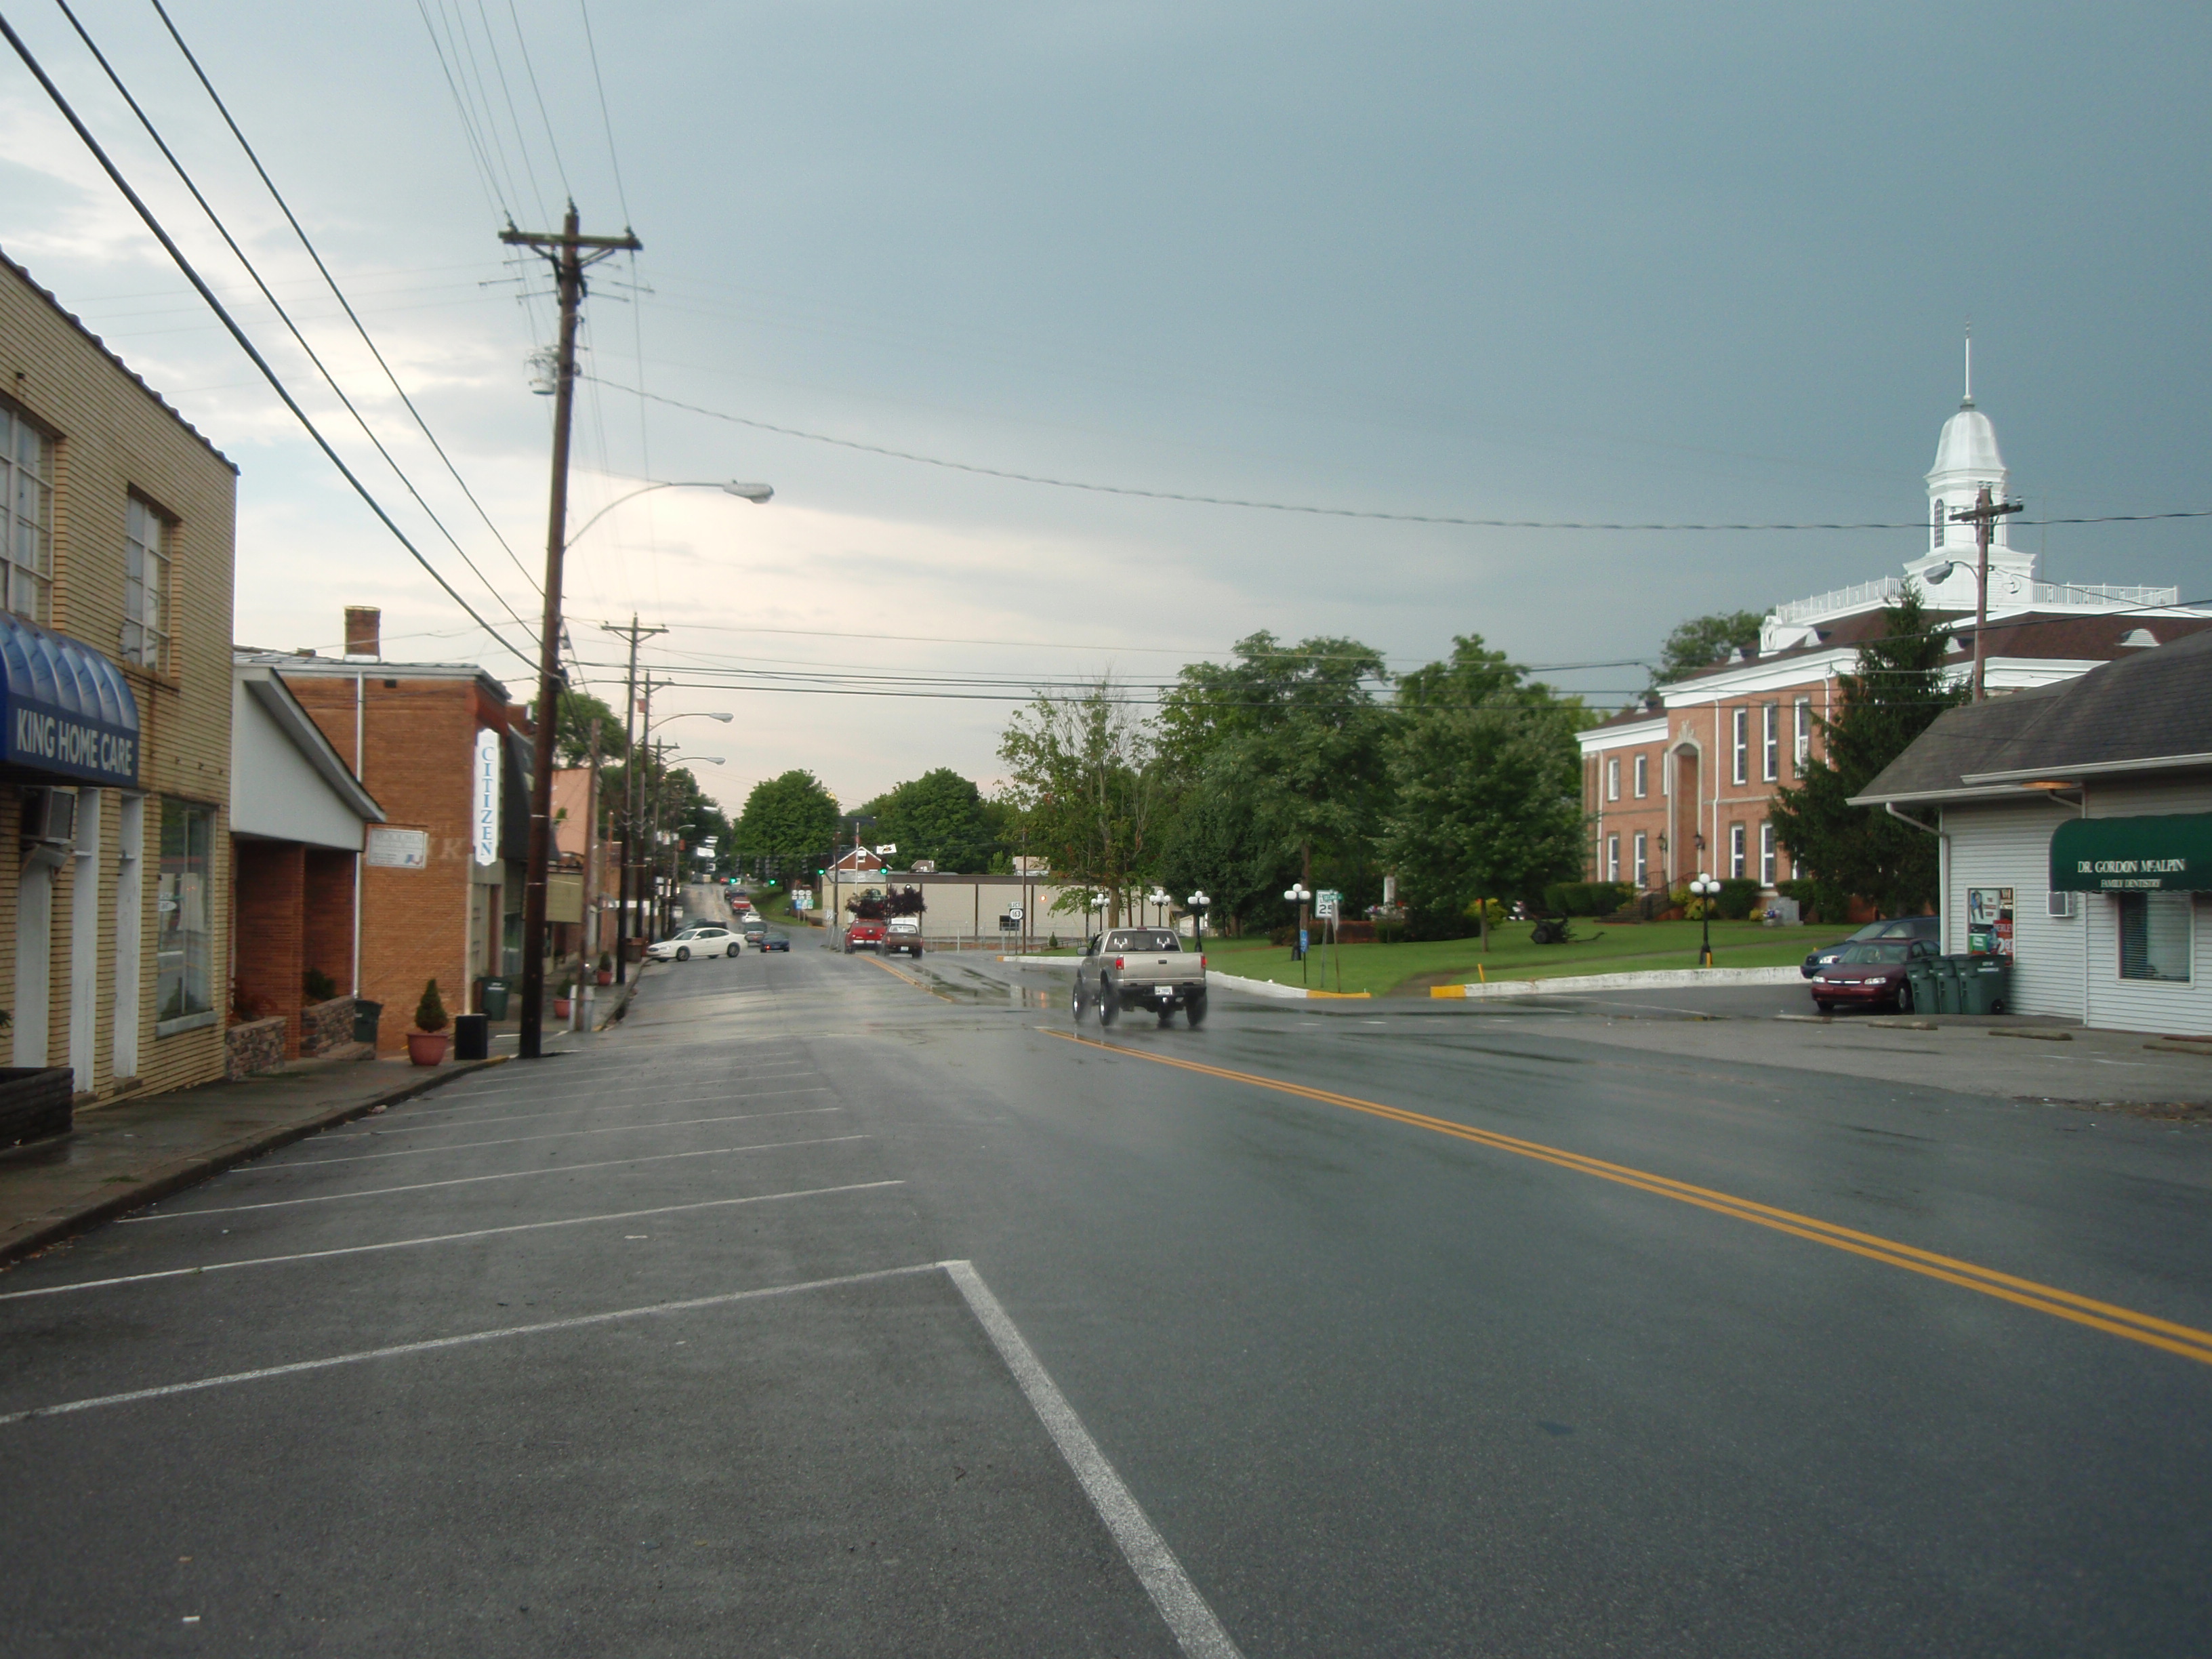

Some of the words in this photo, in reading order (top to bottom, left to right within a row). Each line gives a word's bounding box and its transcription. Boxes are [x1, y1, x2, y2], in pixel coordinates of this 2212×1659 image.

[17, 708, 55, 758] KING
[58, 720, 98, 769] HOME
[101, 733, 132, 777] CARE
[480, 746, 495, 856] CITIZEN
[2077, 861, 2093, 873] DR.
[2095, 860, 2137, 874] GORDON
[2101, 879, 2123, 888] FAMILY
[2125, 878, 2162, 888] DENTISTRY
